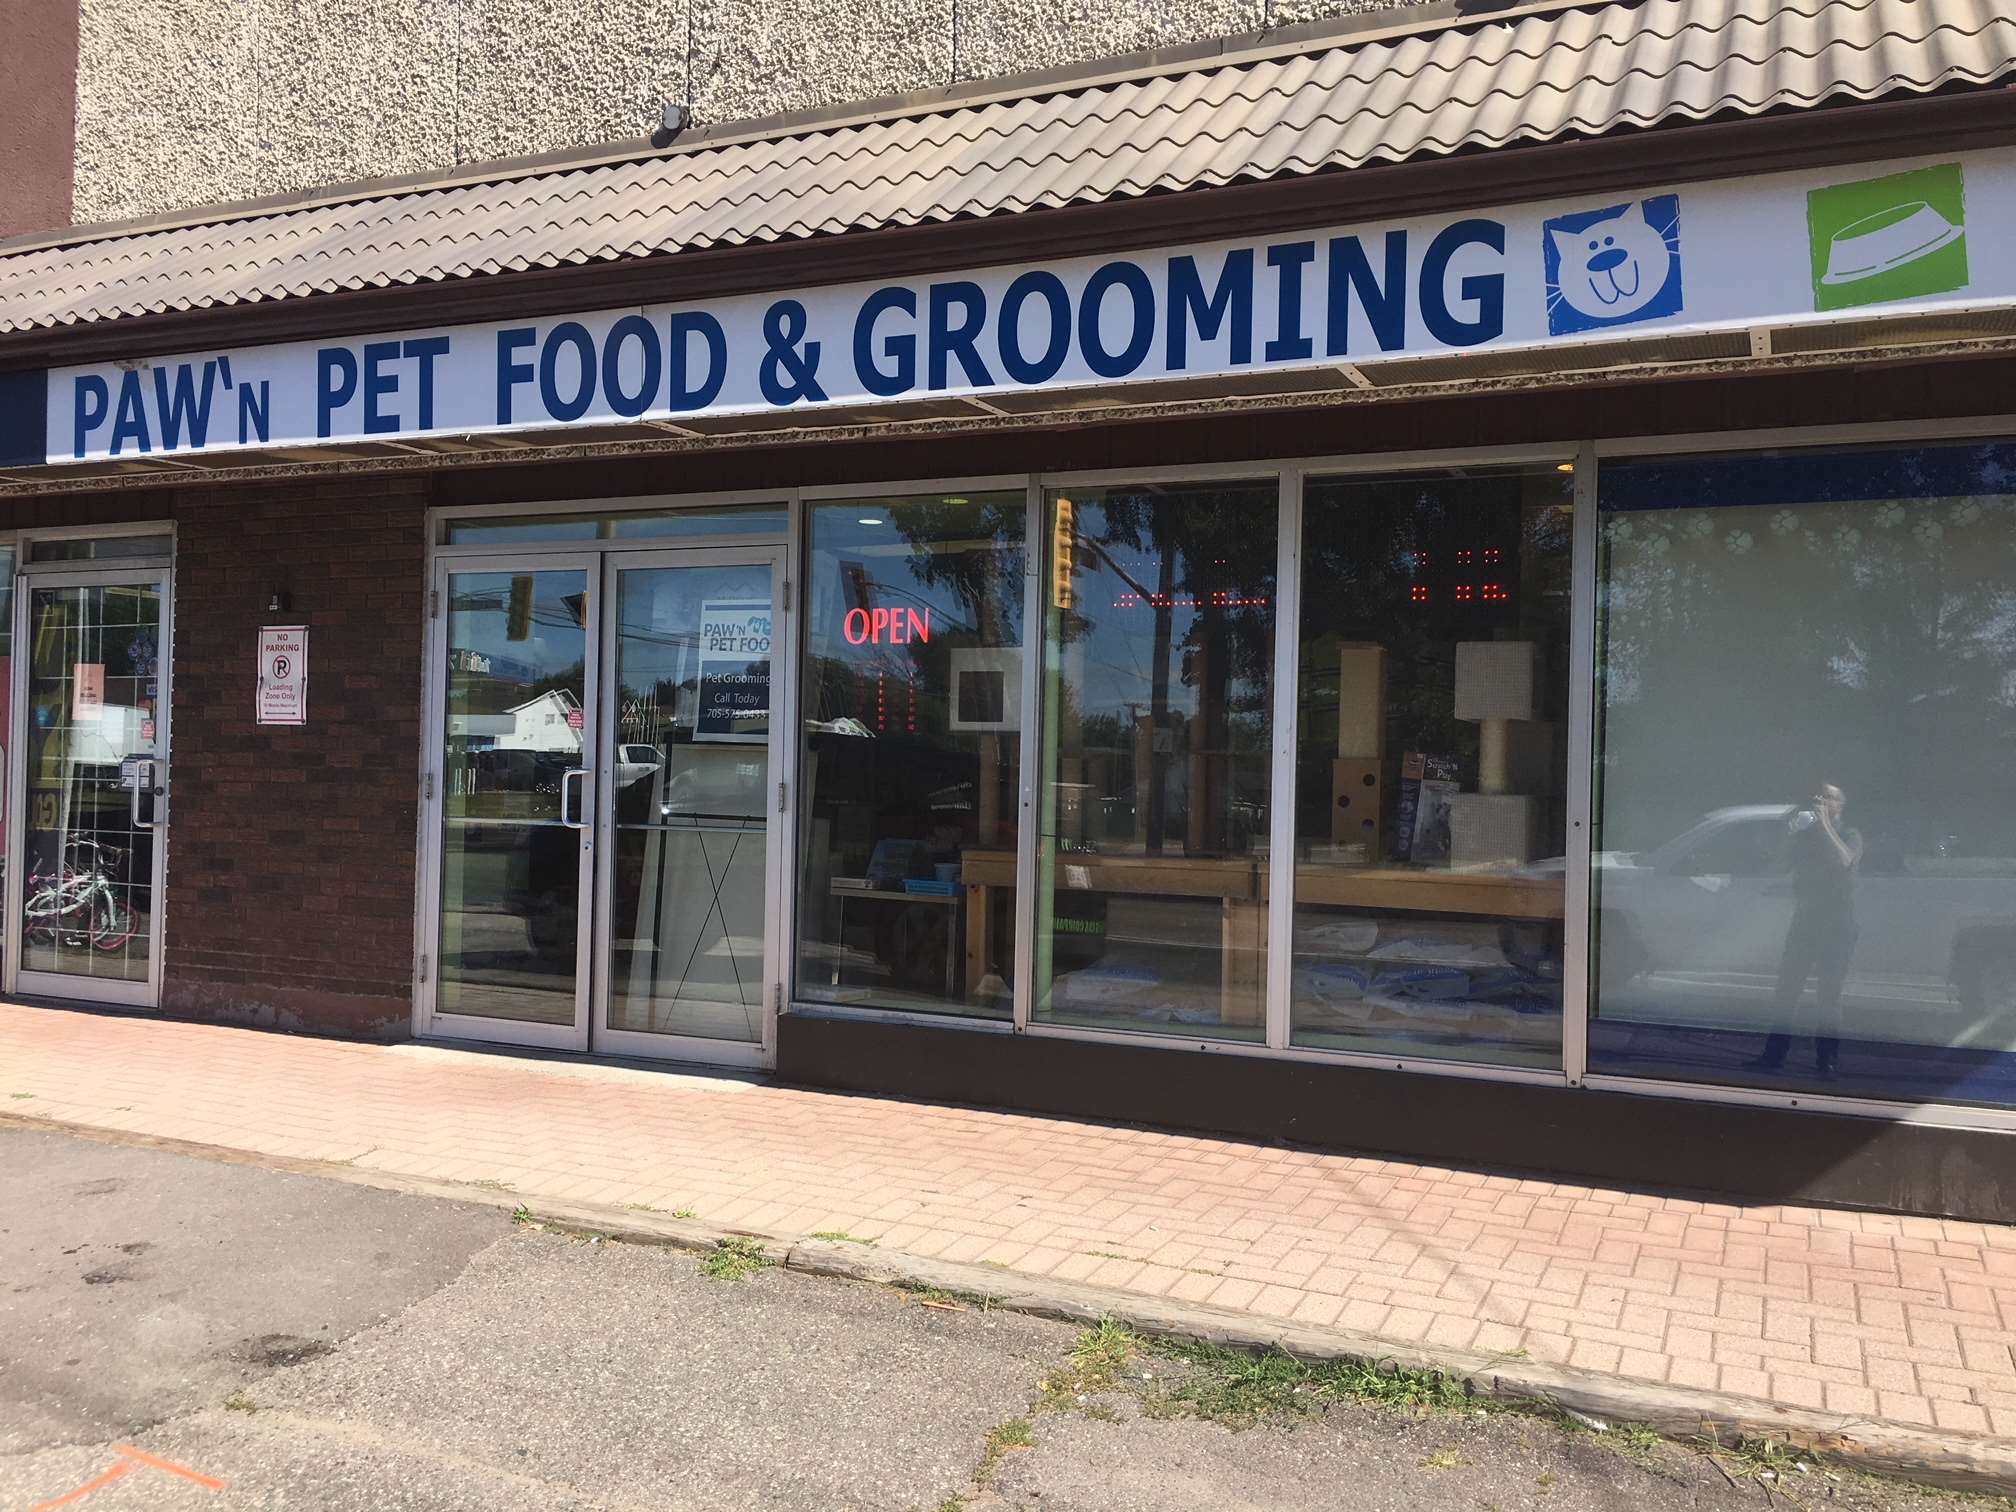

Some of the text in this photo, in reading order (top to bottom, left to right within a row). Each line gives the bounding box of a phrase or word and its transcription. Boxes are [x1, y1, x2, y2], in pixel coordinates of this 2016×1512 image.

[317, 336, 450, 438] PET
[497, 311, 727, 425] FOOD
[759, 300, 829, 406] &
[853, 219, 1505, 397] GROOMING
[703, 623, 746, 637] PAW'N
[843, 607, 930, 645] OPEN
[277, 633, 289, 641] NO
[265, 644, 300, 652] PARKING
[710, 637, 771, 652] PET FOO
[705, 672, 771, 687] Pet Grooming
[265, 692, 296, 701] Zone Only
[714, 692, 760, 706] Call Today
